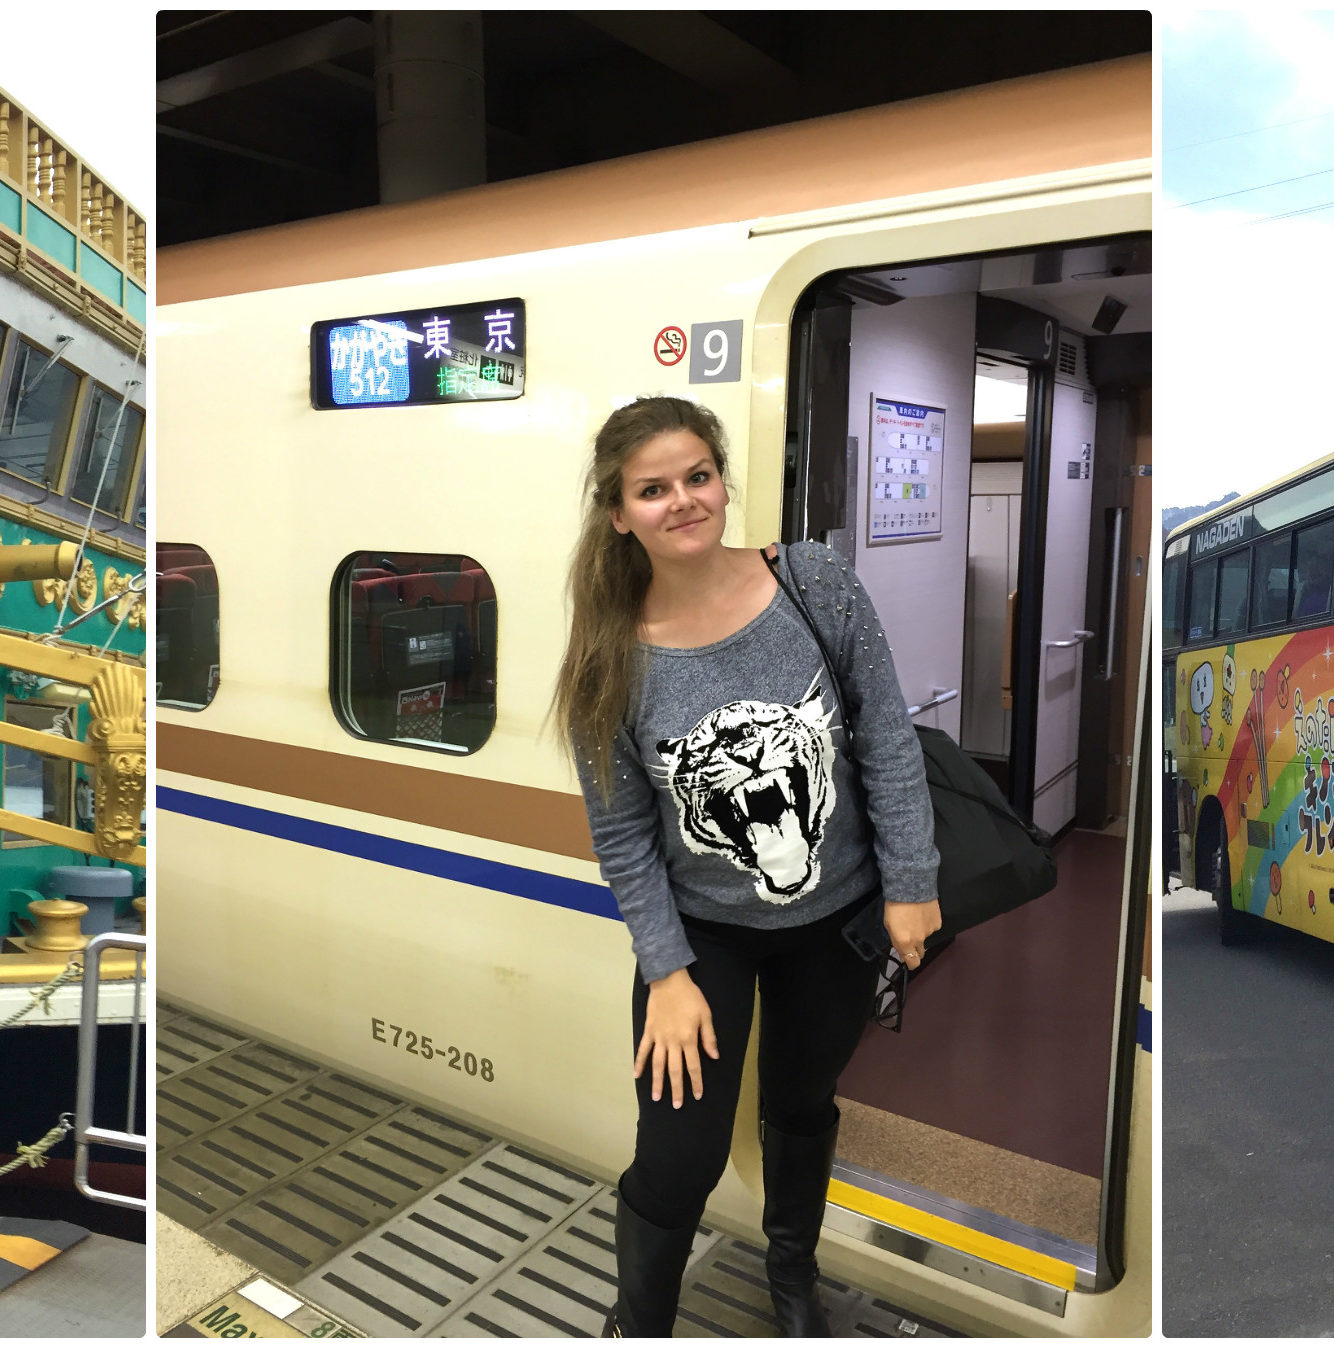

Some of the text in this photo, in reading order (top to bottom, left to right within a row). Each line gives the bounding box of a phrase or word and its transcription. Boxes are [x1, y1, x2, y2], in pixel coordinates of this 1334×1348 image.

[423, 309, 516, 359] 東京
[703, 329, 728, 376] 9
[1044, 320, 1053, 360] 9
[350, 367, 390, 396] 512
[1196, 515, 1244, 554] NAGADEN
[371, 1017, 494, 1082] E725-208
